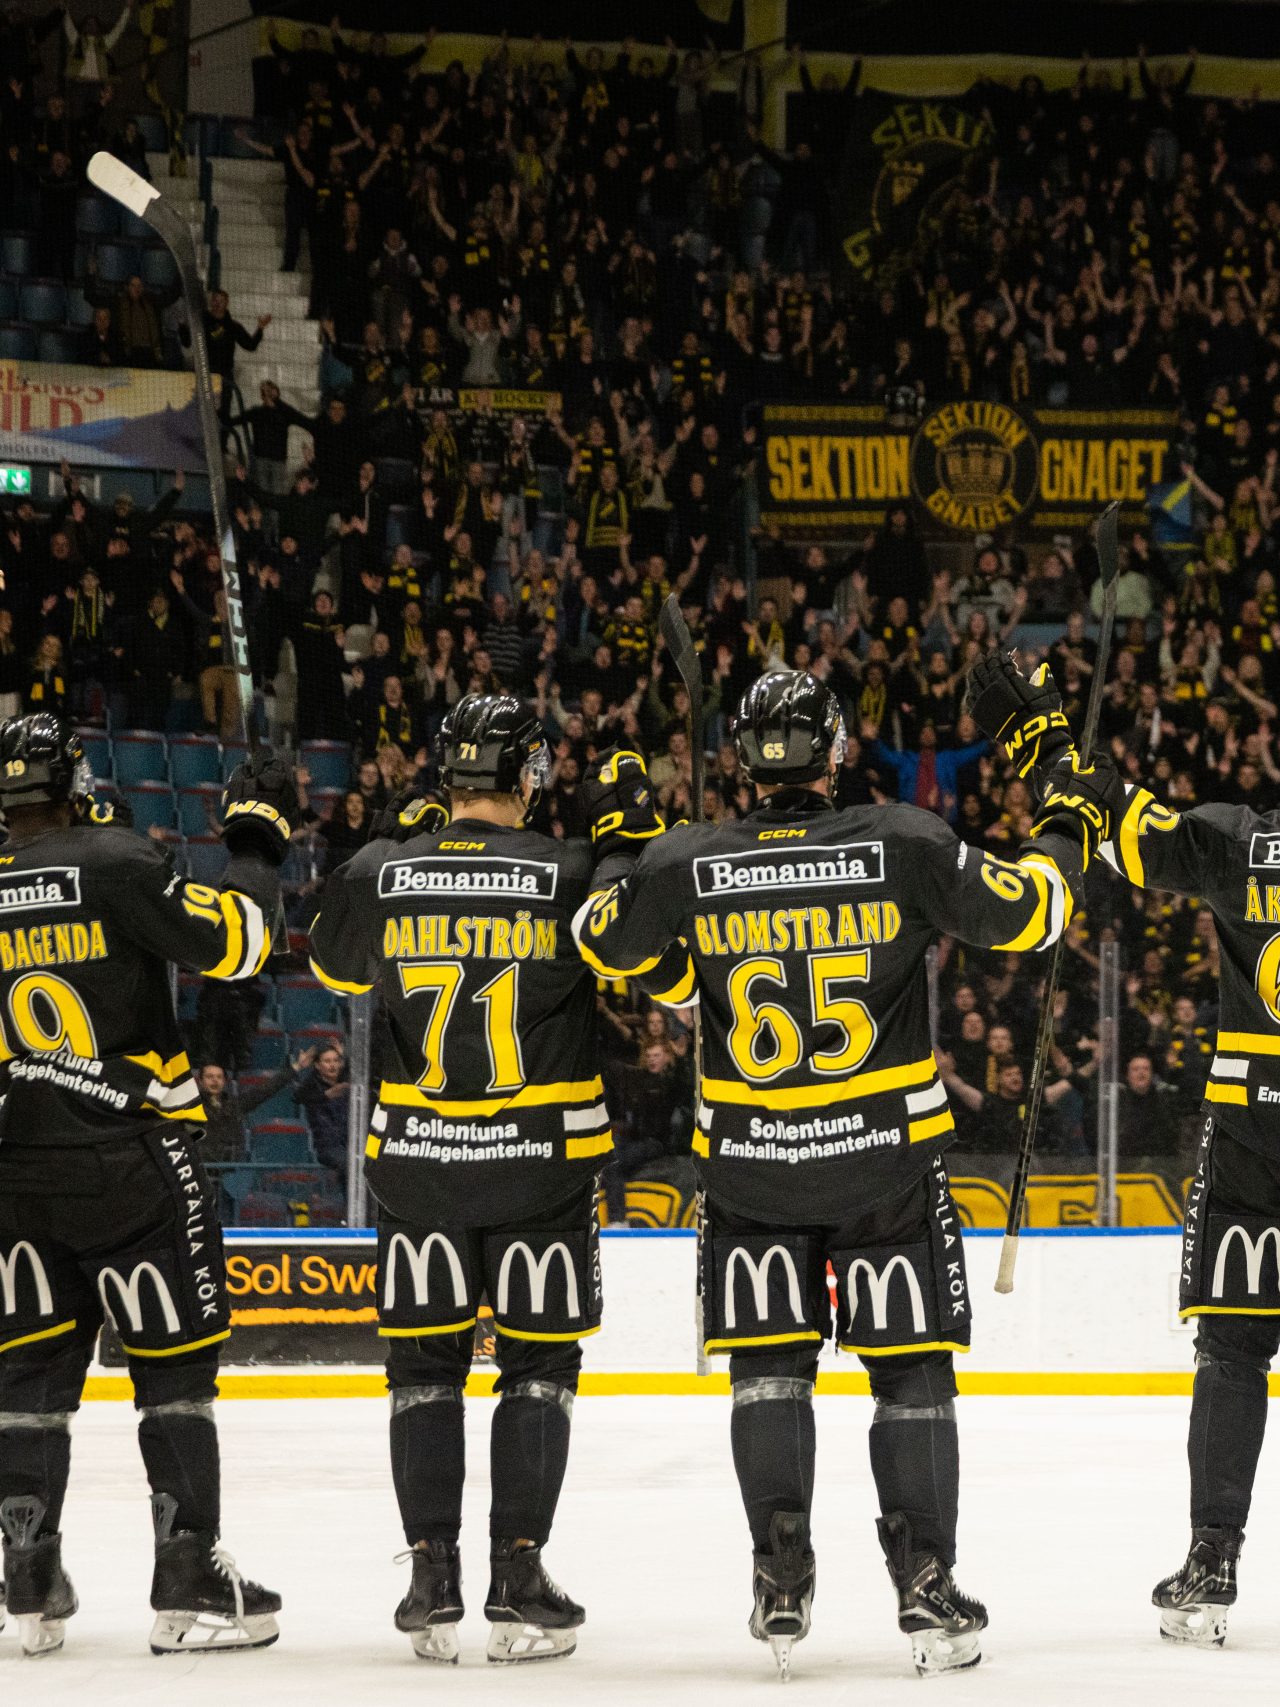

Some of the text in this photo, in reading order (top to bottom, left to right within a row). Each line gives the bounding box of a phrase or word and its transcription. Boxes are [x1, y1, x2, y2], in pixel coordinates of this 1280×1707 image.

[923, 400, 1029, 451] SEKTION
[766, 433, 912, 501] SEKTION
[1040, 437, 1169, 501] GNAGET
[926, 488, 1025, 531] GNAGET
[459, 742, 477, 761] 71
[762, 742, 786, 760] 65
[1004, 711, 1070, 761] CCM
[5, 759, 26, 777] 19
[225, 800, 291, 841] CCM
[757, 829, 808, 841] CCM
[438, 841, 487, 851] CCM
[391, 866, 539, 894] Bemannia
[708, 851, 868, 891] Bemannia
[181, 882, 223, 929] 19
[0, 920, 109, 972] BAGENDA
[383, 910, 558, 960] DAHLSTRÖM
[694, 900, 902, 956] BLOMSTRAND
[397, 961, 527, 1094] 71
[726, 948, 878, 1083] 65
[405, 1115, 519, 1143] Sollentuna
[718, 1127, 902, 1165] Emballagehantering
[749, 1112, 865, 1142] Sollentuna
[161, 1135, 219, 1320] JÄRFÄLLA KÖK
[225, 1253, 293, 1296] Sol
[947, 1260, 965, 1318] KÖK
